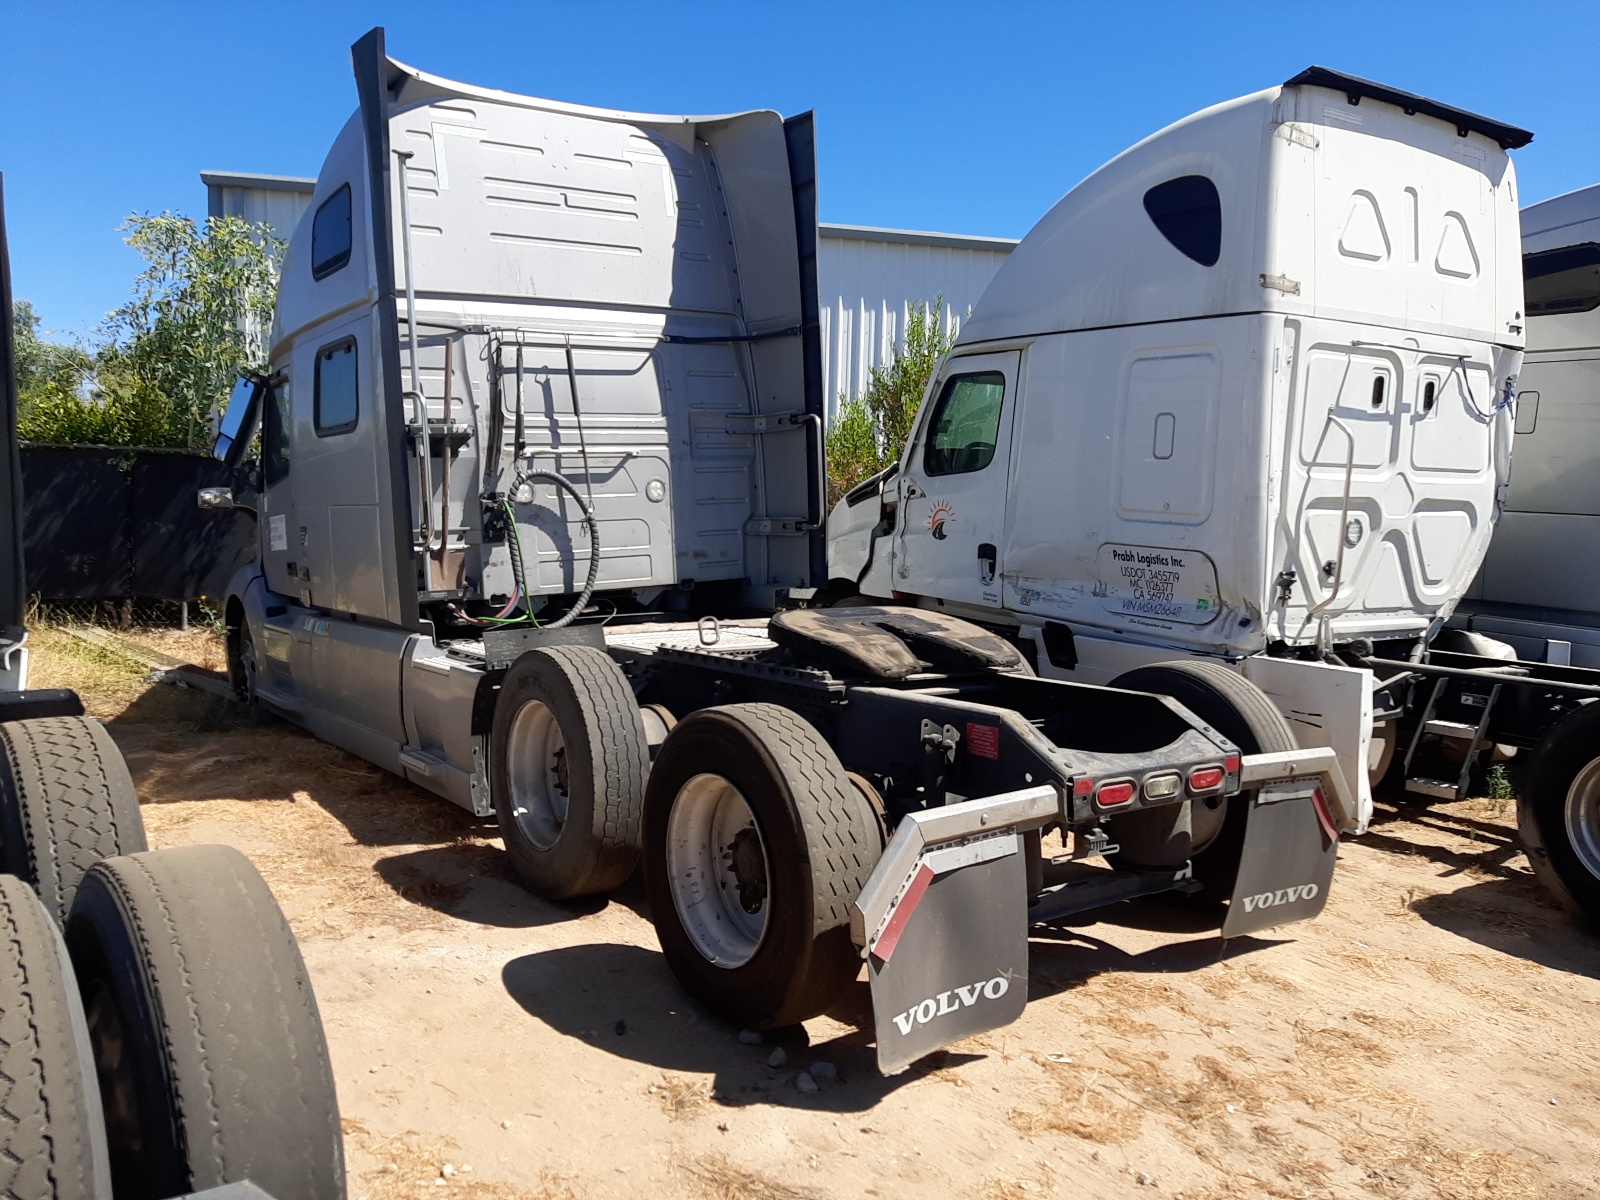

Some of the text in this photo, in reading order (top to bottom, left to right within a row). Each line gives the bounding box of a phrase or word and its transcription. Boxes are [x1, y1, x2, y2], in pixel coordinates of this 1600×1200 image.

[1112, 549, 1186, 568] Prabh Logistics Inc.
[1120, 566, 1180, 582] USDOT 3455719
[1129, 579, 1174, 592] MC 1126377
[1133, 588, 1174, 603] CA 569747
[1122, 599, 1138, 611] VIN
[1242, 883, 1319, 913] VOLVO
[892, 977, 1009, 1036] VOLVO
